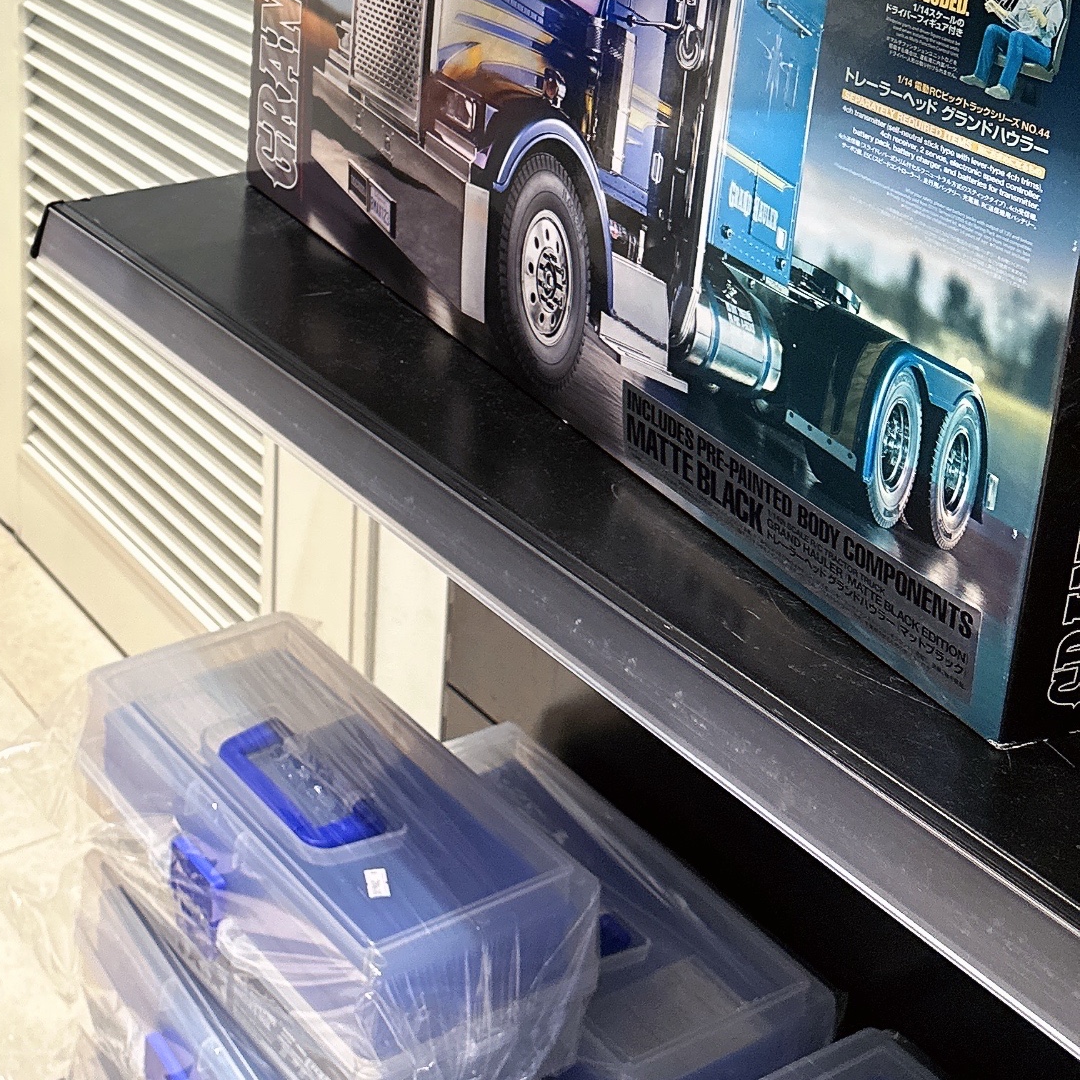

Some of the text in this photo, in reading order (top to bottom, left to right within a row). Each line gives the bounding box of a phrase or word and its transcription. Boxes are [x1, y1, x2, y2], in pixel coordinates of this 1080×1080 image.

[885, 3, 964, 38] ドライバーフィギュア付き
[913, 4, 965, 28] 1/14スケールの
[842, 105, 853, 115] 4ch
[854, 110, 886, 128] transmitter
[924, 139, 939, 150] stick
[940, 145, 954, 157] type
[956, 152, 970, 162] with
[971, 156, 1005, 177] lever-type
[1006, 172, 1020, 182] 4ch
[843, 91, 973, 149] SEPARATELY REQUIRED ITEMS
[845, 66, 1049, 155] トレーラーヘッド グランドハウラー
[897, 74, 1051, 140] 1/14 電動RCビッグトラックシリーズ NO.44
[852, 127, 1040, 211] battery pack, battery charger, and batteries for transmitter.
[879, 130, 892, 140] 4ch
[892, 135, 919, 152] receiver,
[920, 146, 925, 154] 2
[925, 151, 948, 165] servos,
[950, 159, 982, 177] electronic
[983, 172, 1005, 187] speed
[1005, 180, 1042, 202] controller,
[626, 413, 694, 486] MATTE
[696, 459, 764, 535] BLACK
[627, 388, 695, 451] INCLUDES
[697, 434, 793, 518] PRE-PAINTED
[797, 503, 840, 550] BODY
[843, 535, 974, 639] COMPONENTS
[766, 530, 825, 579] トレーラーヘッド
[828, 571, 896, 627] グランドハウラー
[767, 519, 801, 552] GRAND
[803, 544, 844, 577] HAULER
[884, 601, 920, 632] BLACK
[787, 522, 809, 543] SCALE
[824, 547, 859, 576] TRACTOR
[859, 571, 885, 595] TRUCK
